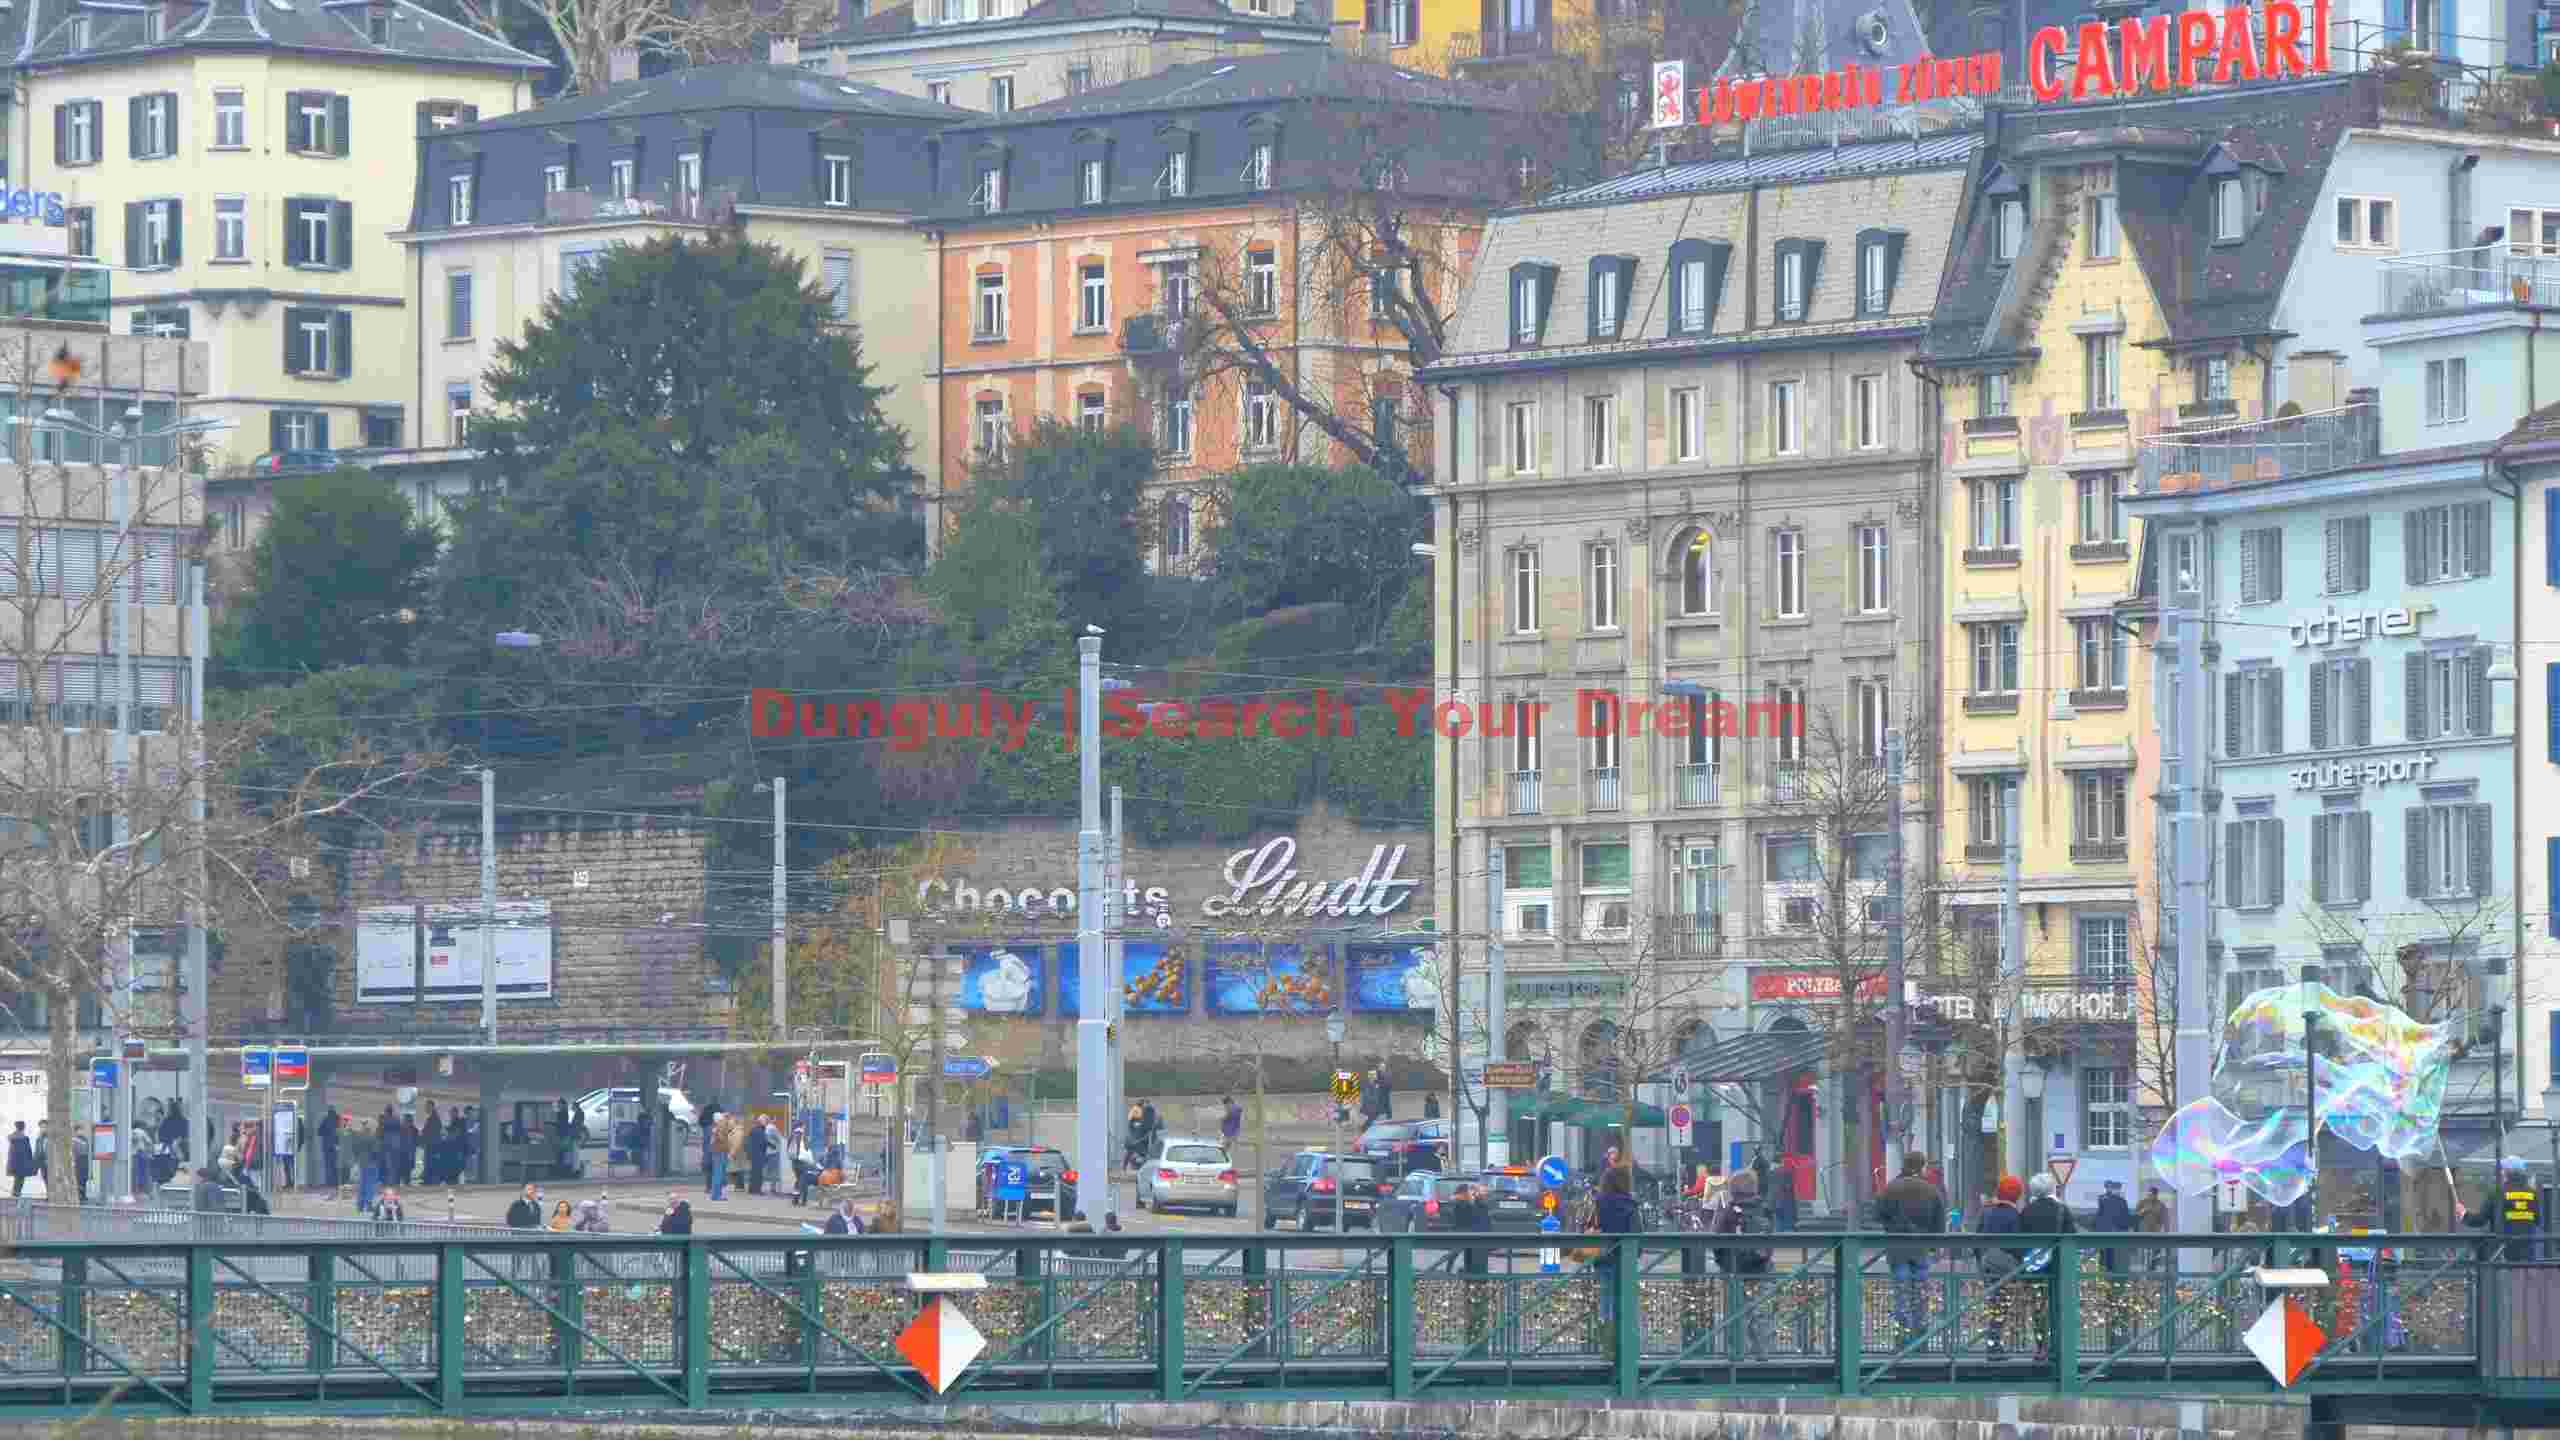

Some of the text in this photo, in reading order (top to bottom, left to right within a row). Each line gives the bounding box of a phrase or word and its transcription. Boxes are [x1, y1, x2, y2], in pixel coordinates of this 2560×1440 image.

[2031, 0, 2332, 101] CAMPARI
[917, 836, 1424, 917] Chocots Lindt
